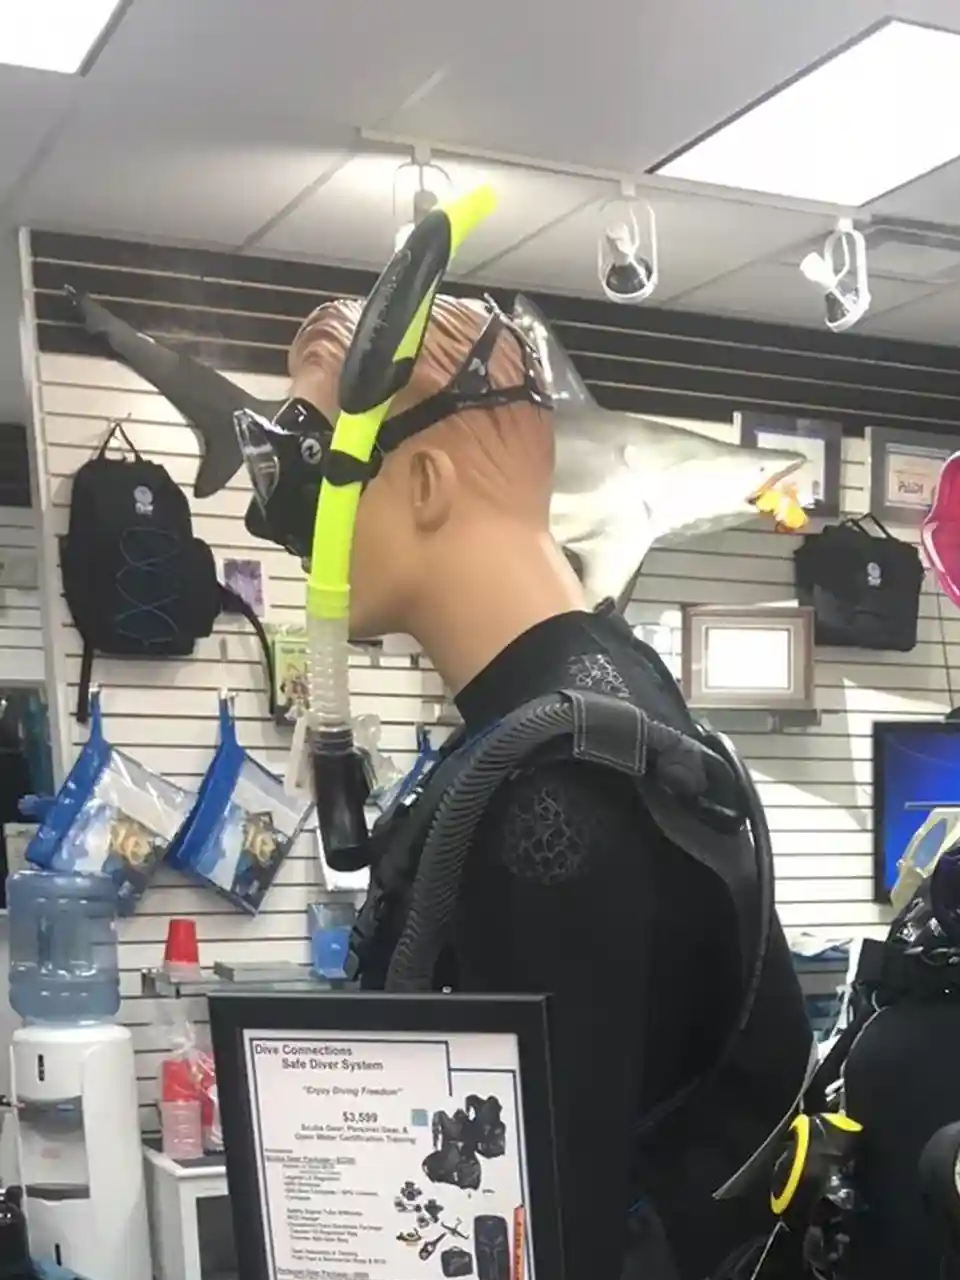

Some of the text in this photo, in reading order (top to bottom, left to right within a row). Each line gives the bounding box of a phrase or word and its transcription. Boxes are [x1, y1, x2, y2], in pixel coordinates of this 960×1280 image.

[254, 1043, 353, 1056] Dive Connections
[282, 1059, 384, 1072] Safe Diver System
